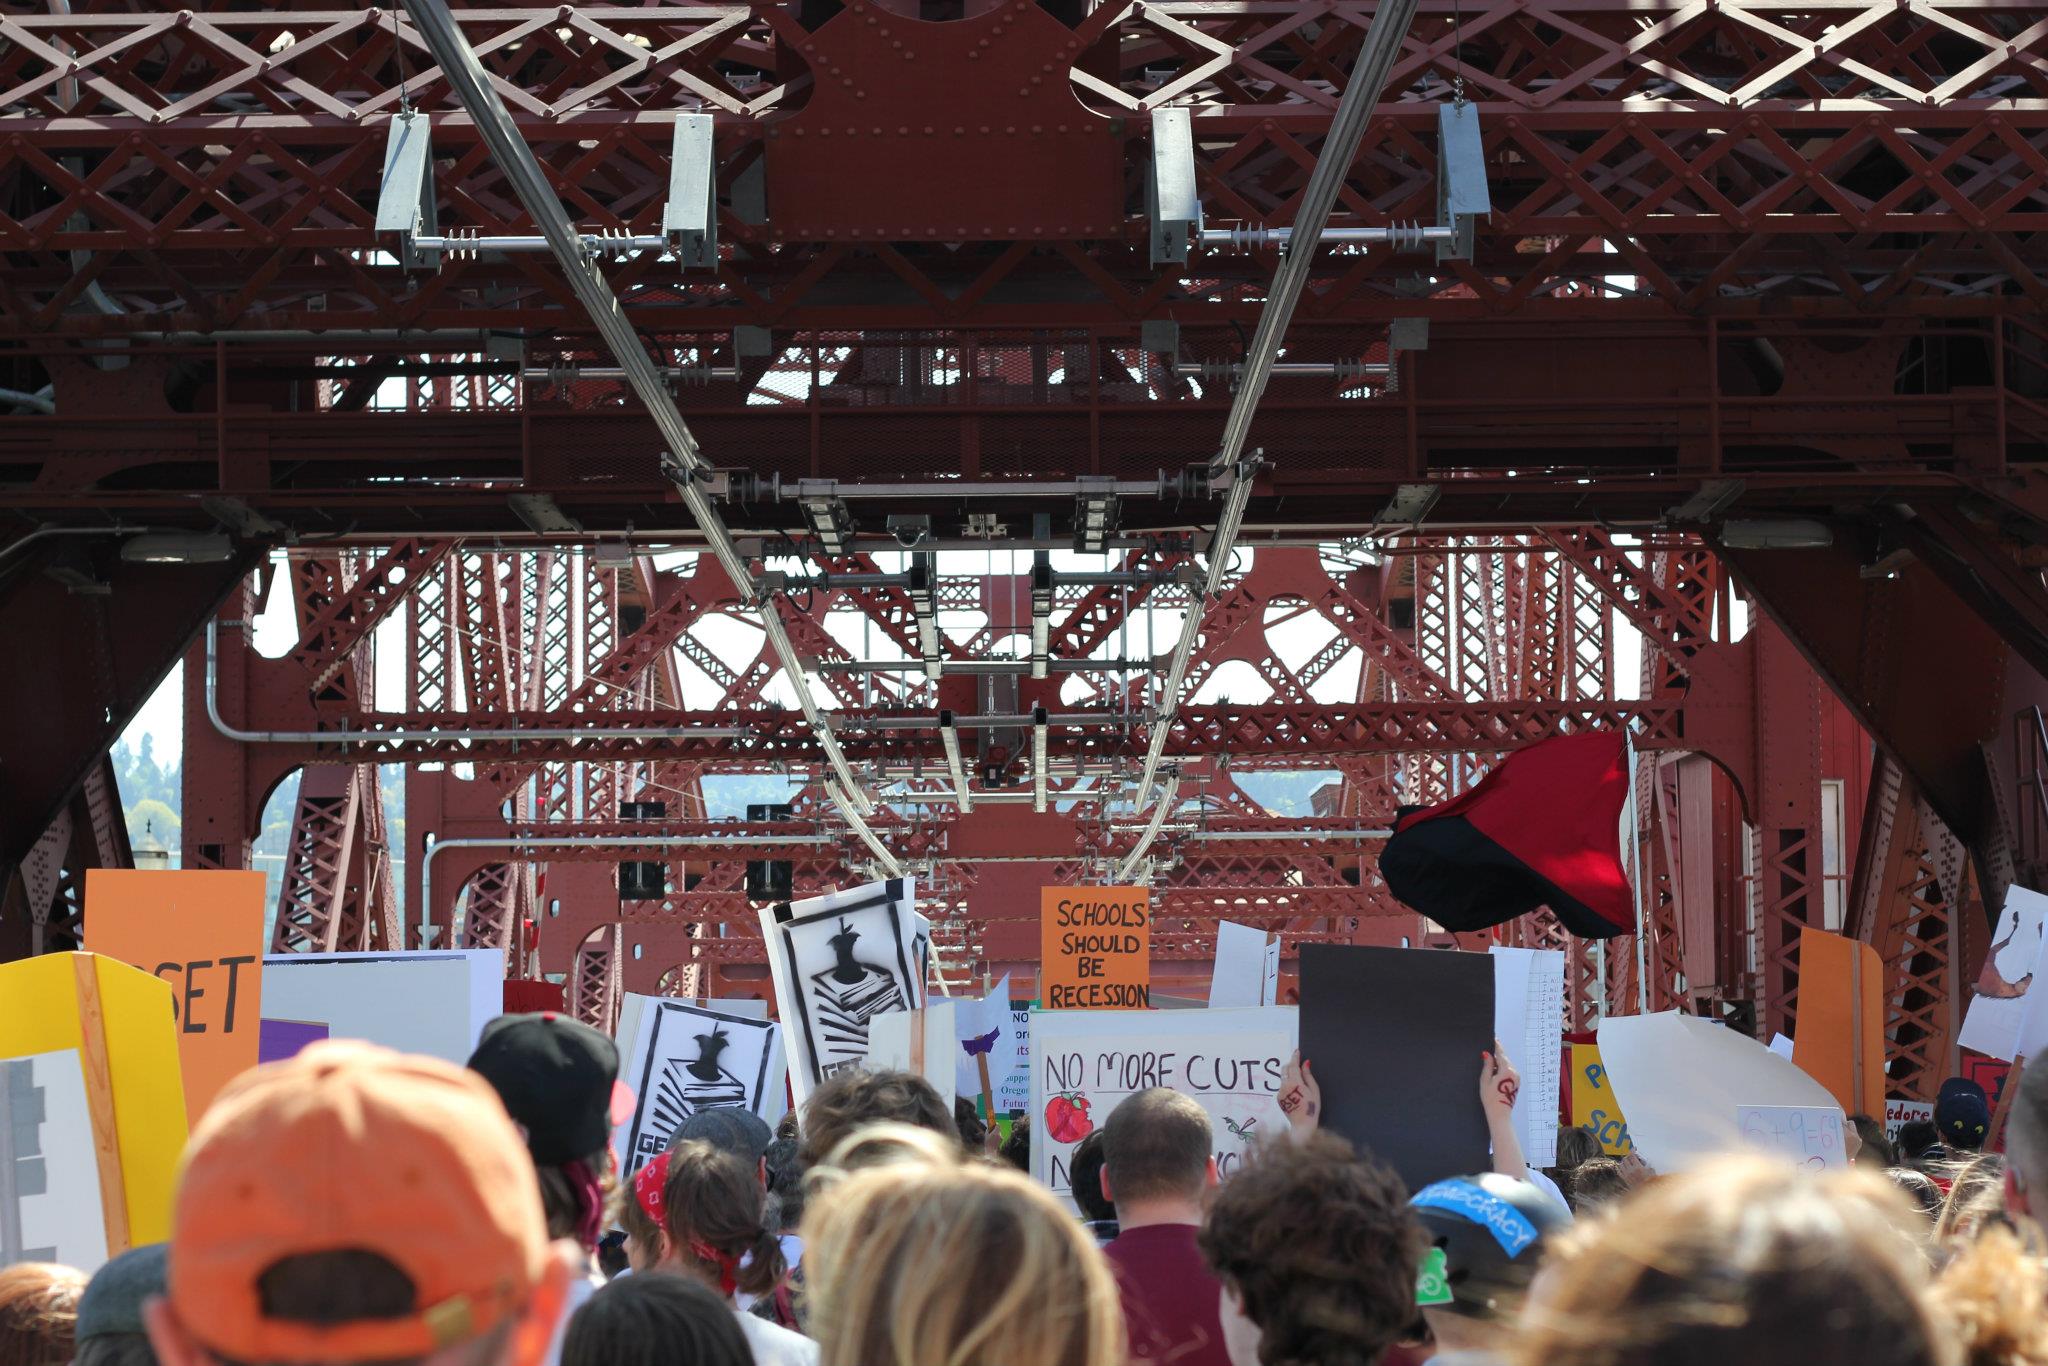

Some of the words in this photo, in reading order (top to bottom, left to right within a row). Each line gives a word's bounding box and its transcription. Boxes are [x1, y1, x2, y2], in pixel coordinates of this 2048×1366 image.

[1057, 899, 1145, 927] SCHOOLS
[1061, 932, 1140, 955] SHOULD
[1078, 956, 1105, 978] BE
[133, 955, 256, 1034] SET
[1050, 984, 1150, 1008] RECESSION
[1012, 1012, 1029, 1023] NO
[1047, 1053, 1083, 1090] NO
[1097, 1051, 1176, 1090] MORE
[1186, 1055, 1281, 1092] CUTS
